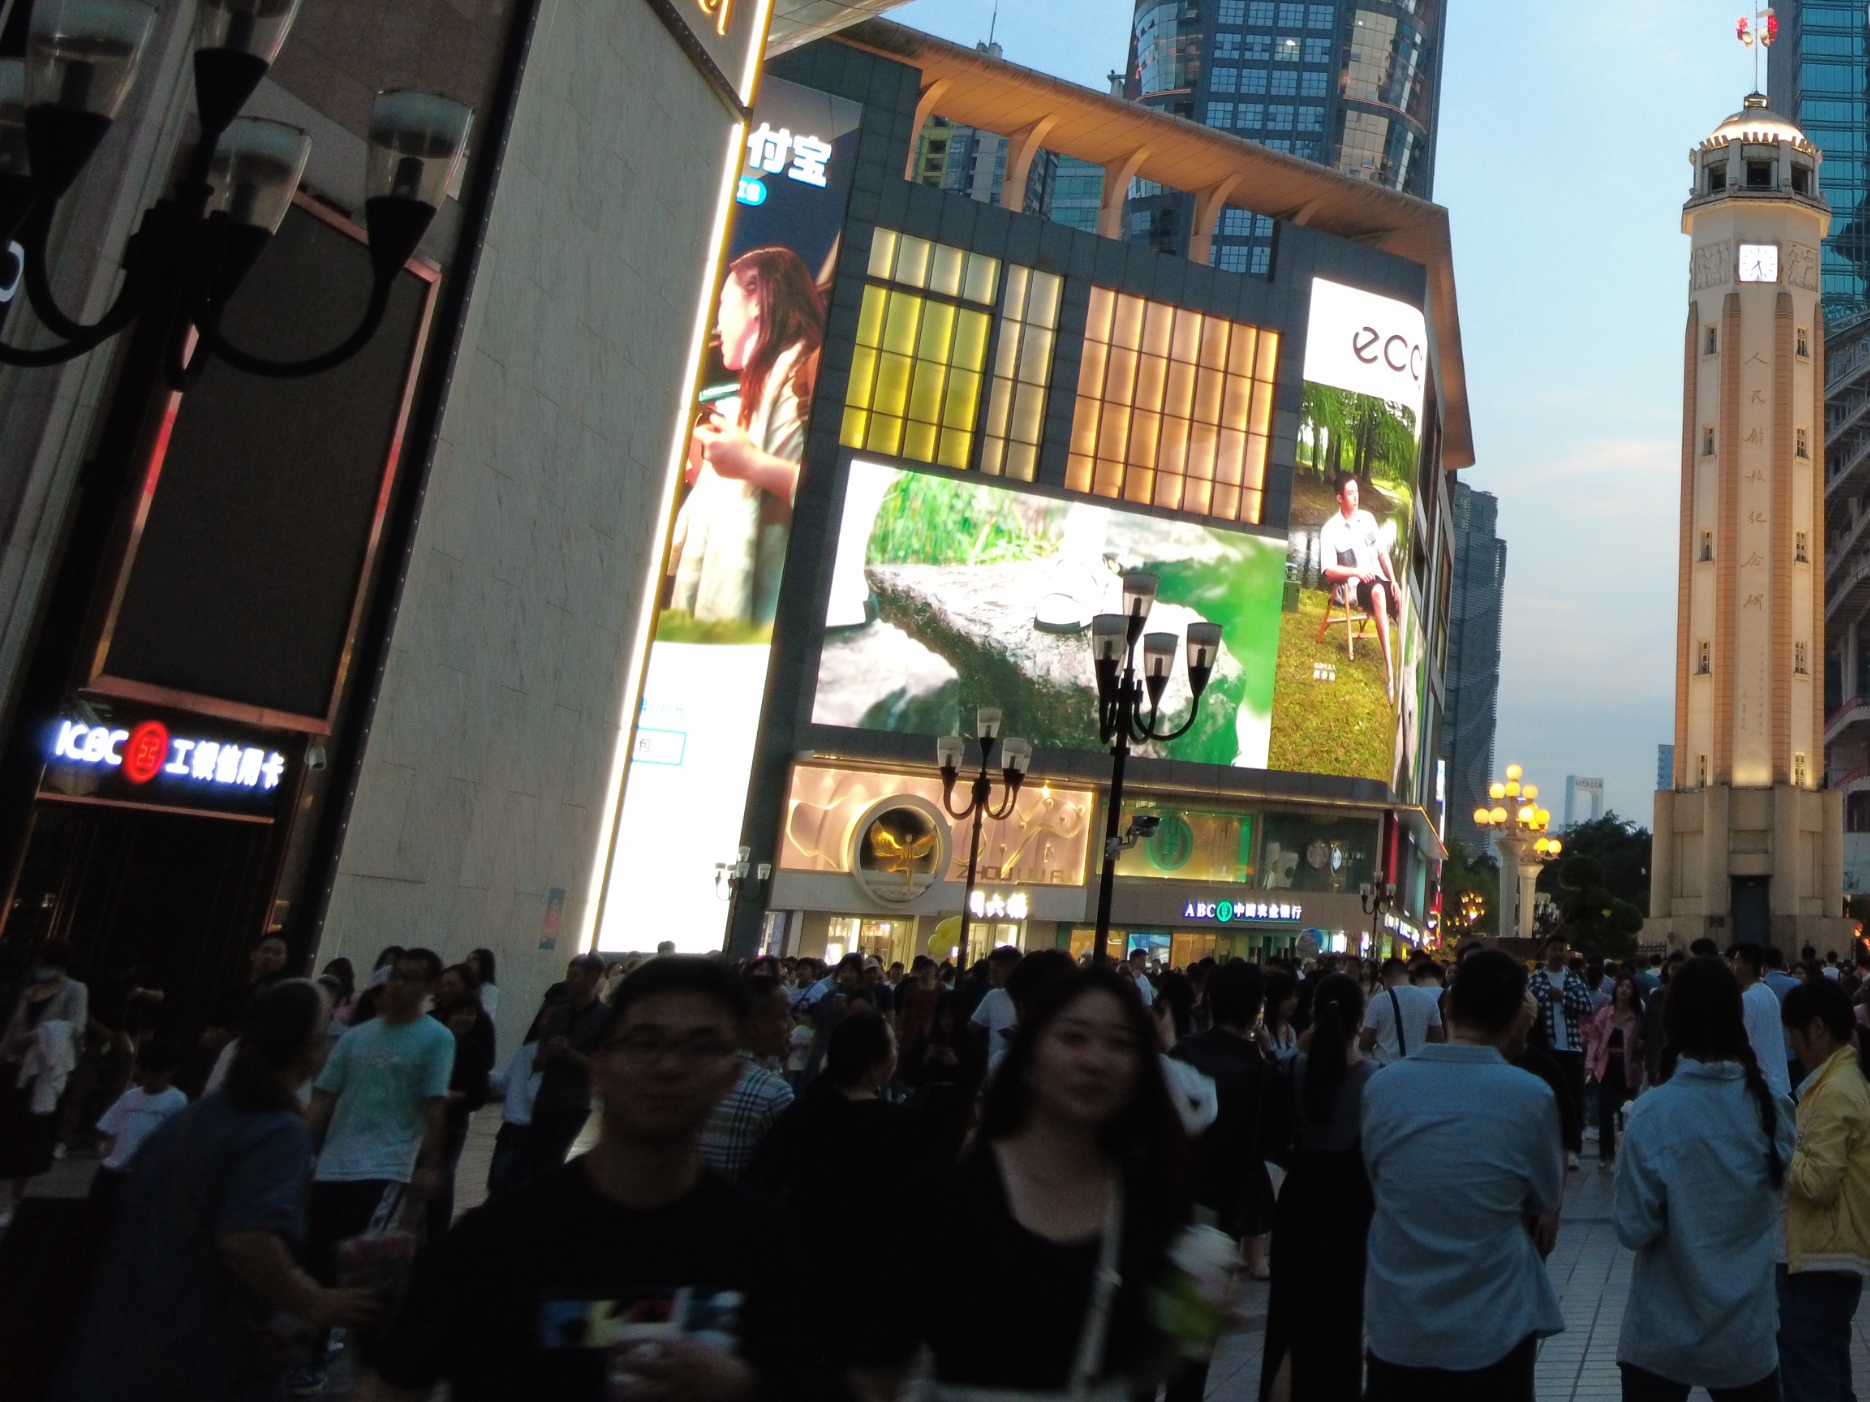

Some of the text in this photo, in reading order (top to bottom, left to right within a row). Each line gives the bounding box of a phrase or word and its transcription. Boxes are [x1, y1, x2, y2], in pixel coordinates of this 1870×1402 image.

[55, 720, 130, 766] ICBC
[1184, 902, 1217, 919] ABC
[1233, 902, 1302, 920] 中国农业银行
